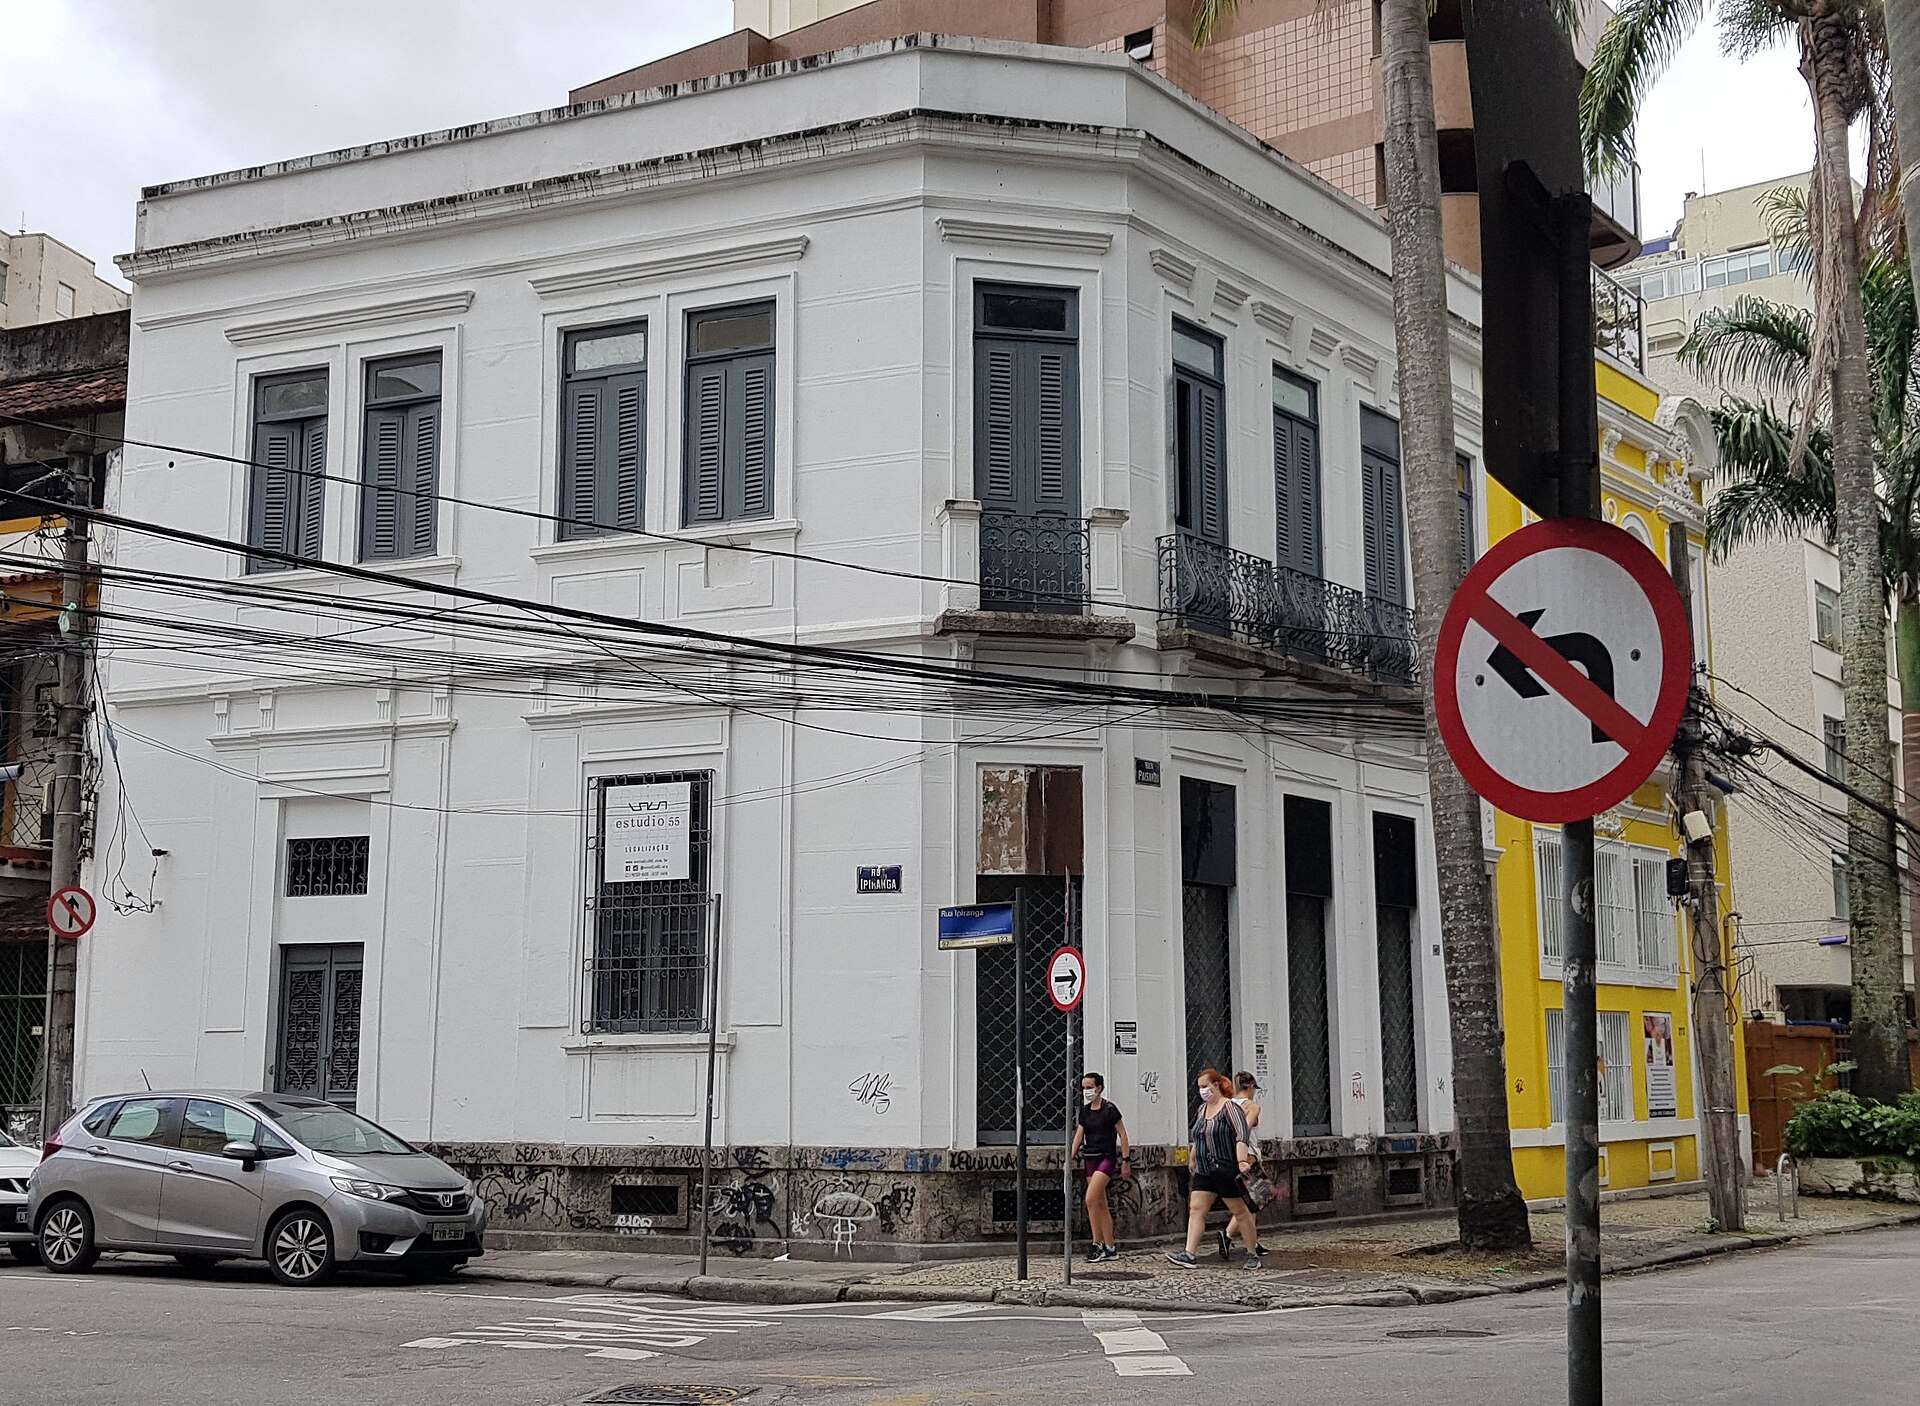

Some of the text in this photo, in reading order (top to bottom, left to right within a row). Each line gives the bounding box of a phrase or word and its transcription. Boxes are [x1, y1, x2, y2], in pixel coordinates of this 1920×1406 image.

[616, 815, 680, 828] estudio 55
[625, 844, 669, 853] LEGALIZAÇÃO
[860, 879, 897, 890] IPIRANGA
[940, 909, 984, 918] Rua Ipiranga
